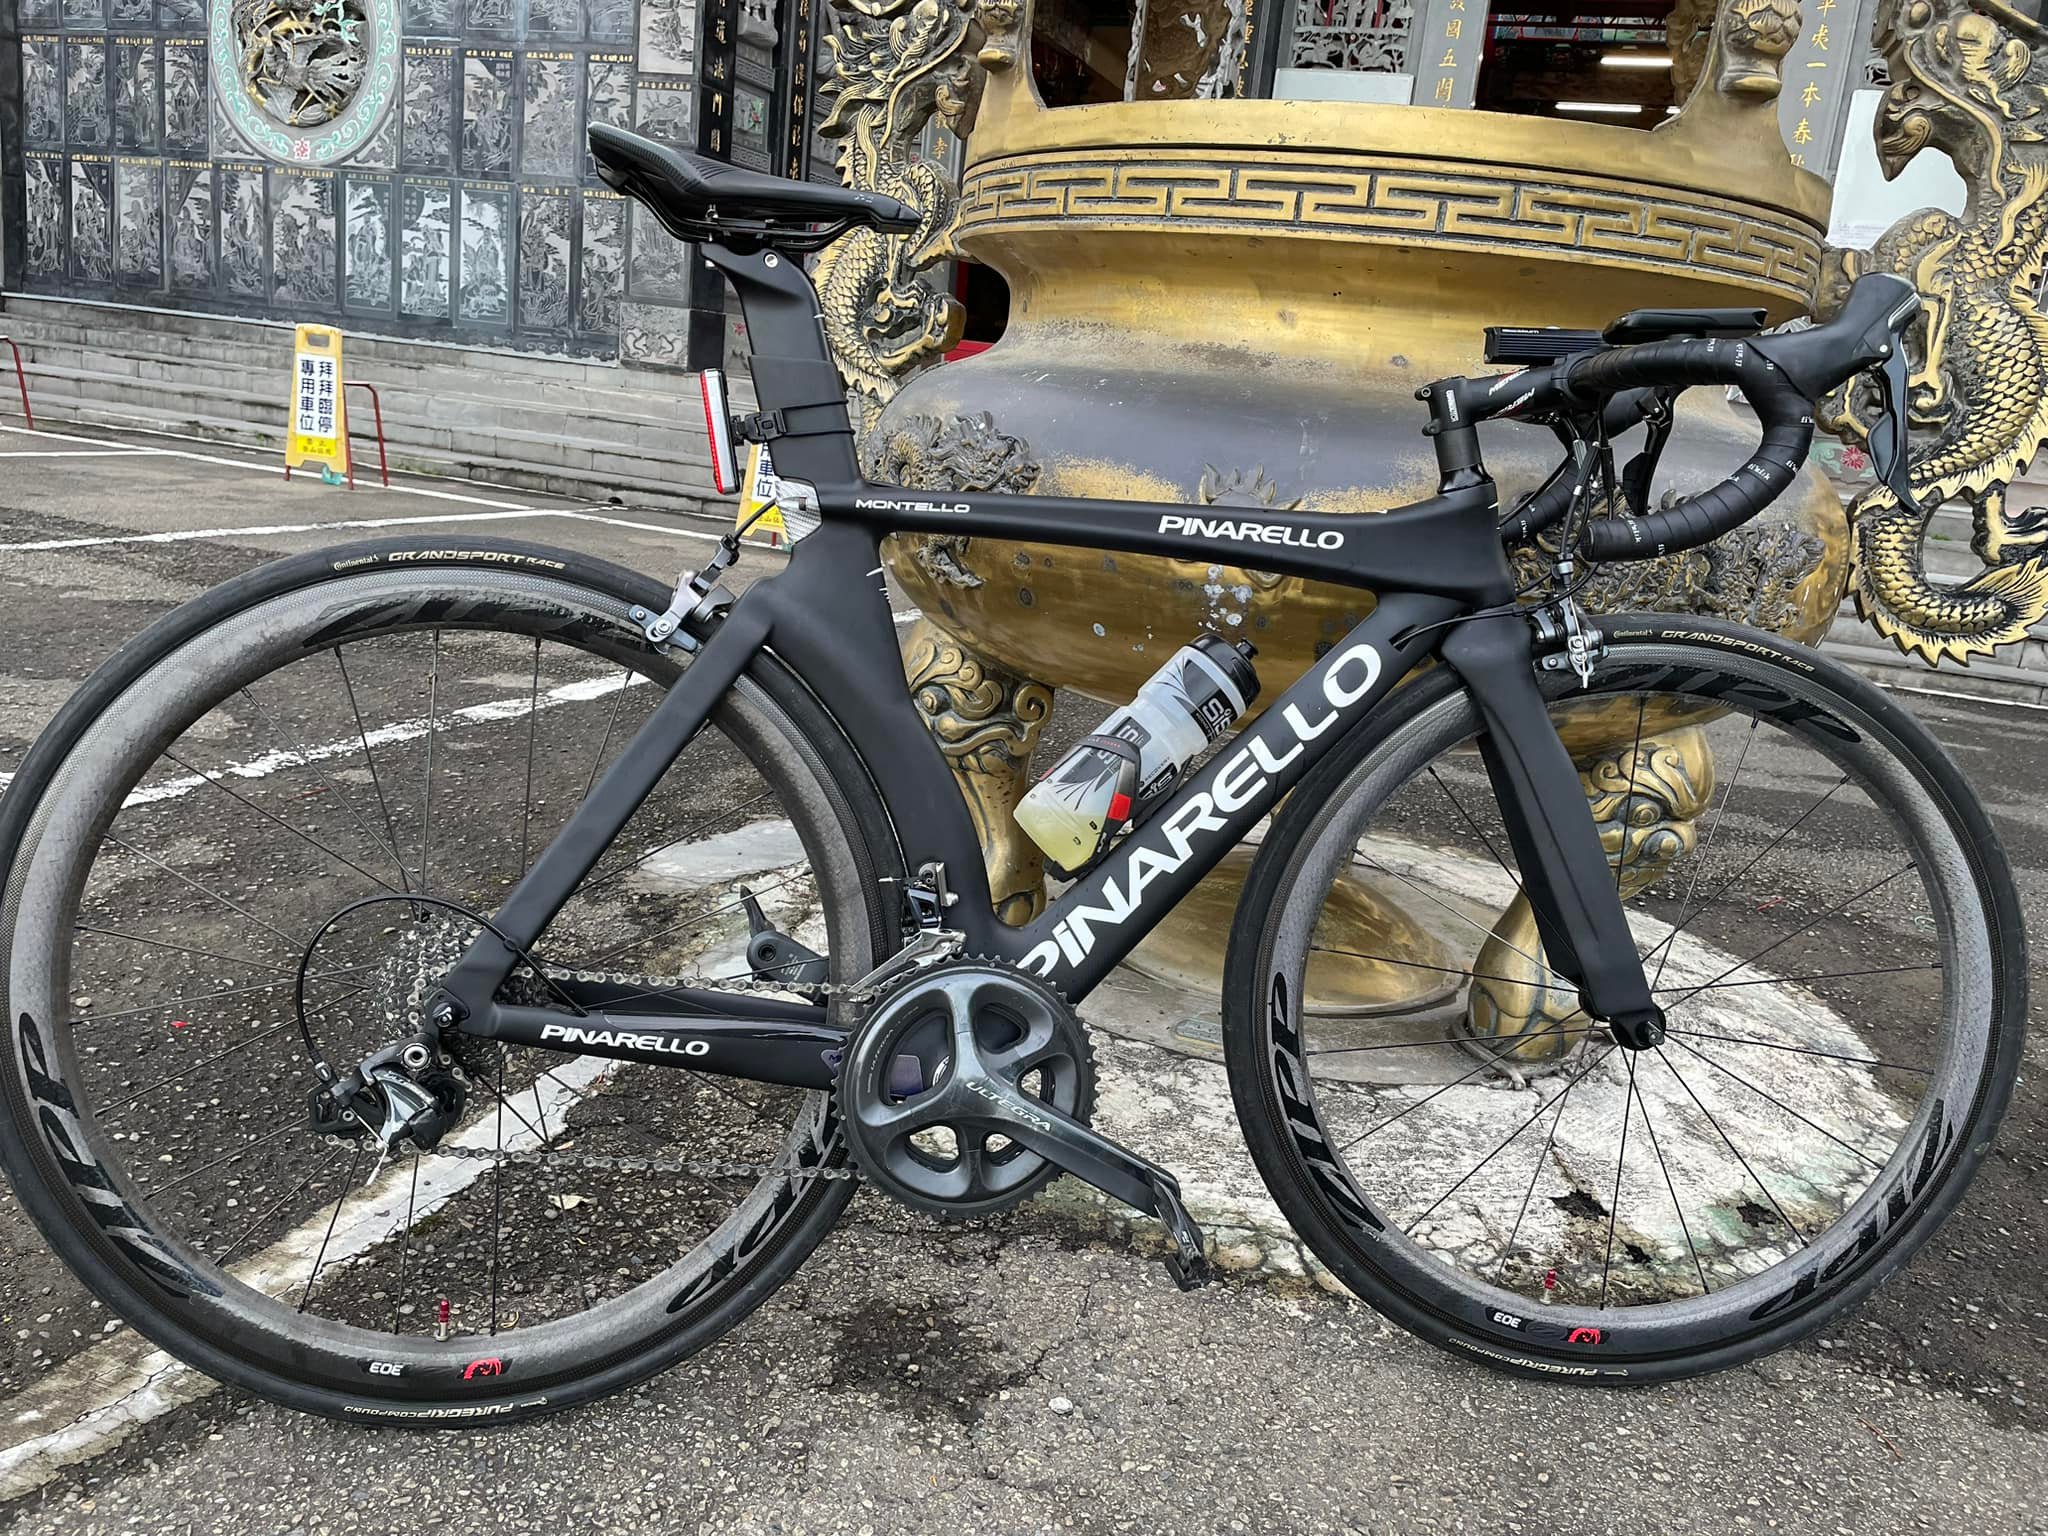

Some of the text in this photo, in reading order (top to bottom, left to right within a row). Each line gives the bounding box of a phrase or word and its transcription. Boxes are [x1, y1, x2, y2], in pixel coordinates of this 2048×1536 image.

[300, 359, 315, 431] 專用車位
[318, 361, 333, 433] 拜拜臨停
[855, 499, 971, 514] MONTELLO
[1158, 514, 1345, 551] PINARELLO
[388, 549, 525, 564] GRANDSPORT
[525, 556, 567, 570] RACE
[1660, 629, 1783, 660] GRANDSPORT
[1782, 654, 1816, 673] RACE
[1016, 643, 1382, 978] PINARELLO
[540, 1023, 710, 1056] PINARELLO
[966, 1080, 1052, 1132] ULTEGRA
[1447, 1337, 1599, 1377] PUREGRIP COMPOUND
[343, 1402, 514, 1418] PUREGRIP COMPOUND
